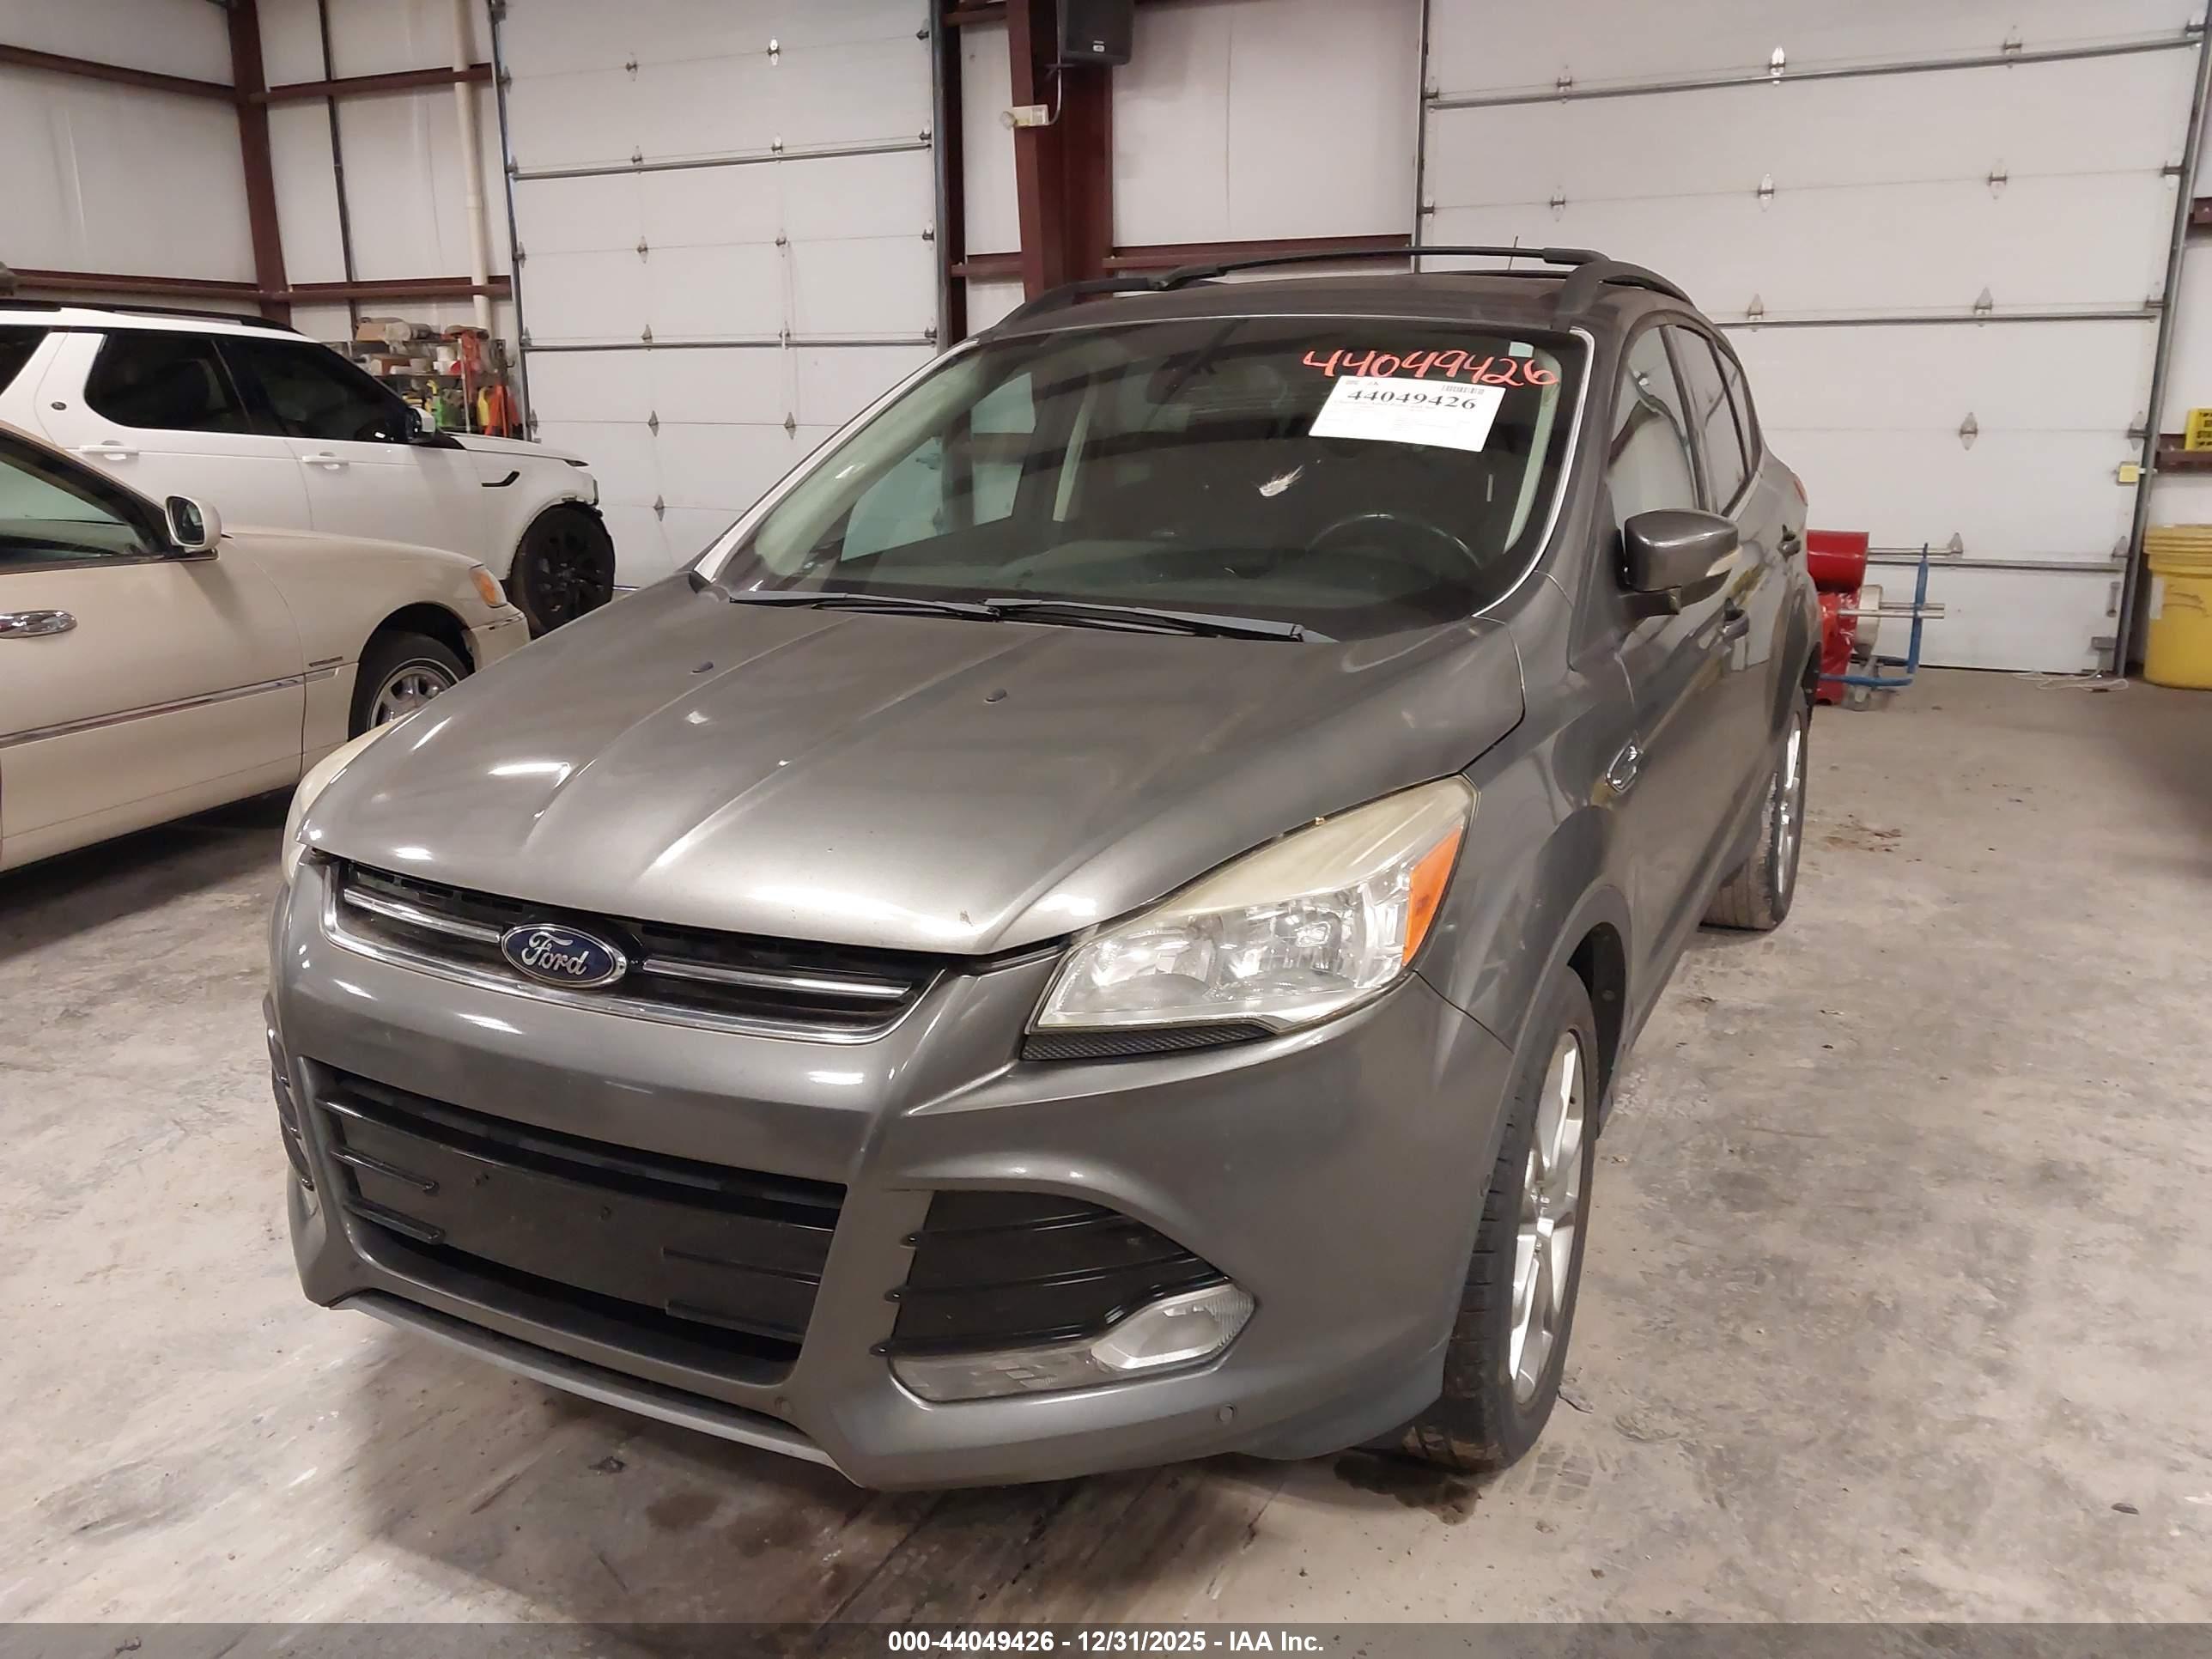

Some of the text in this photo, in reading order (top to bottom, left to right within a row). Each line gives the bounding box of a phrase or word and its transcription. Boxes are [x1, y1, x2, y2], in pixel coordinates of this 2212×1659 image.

[1302, 349, 1559, 386] 44049426
[1346, 389, 1477, 410] 44049426
[521, 931, 590, 975] Ford
